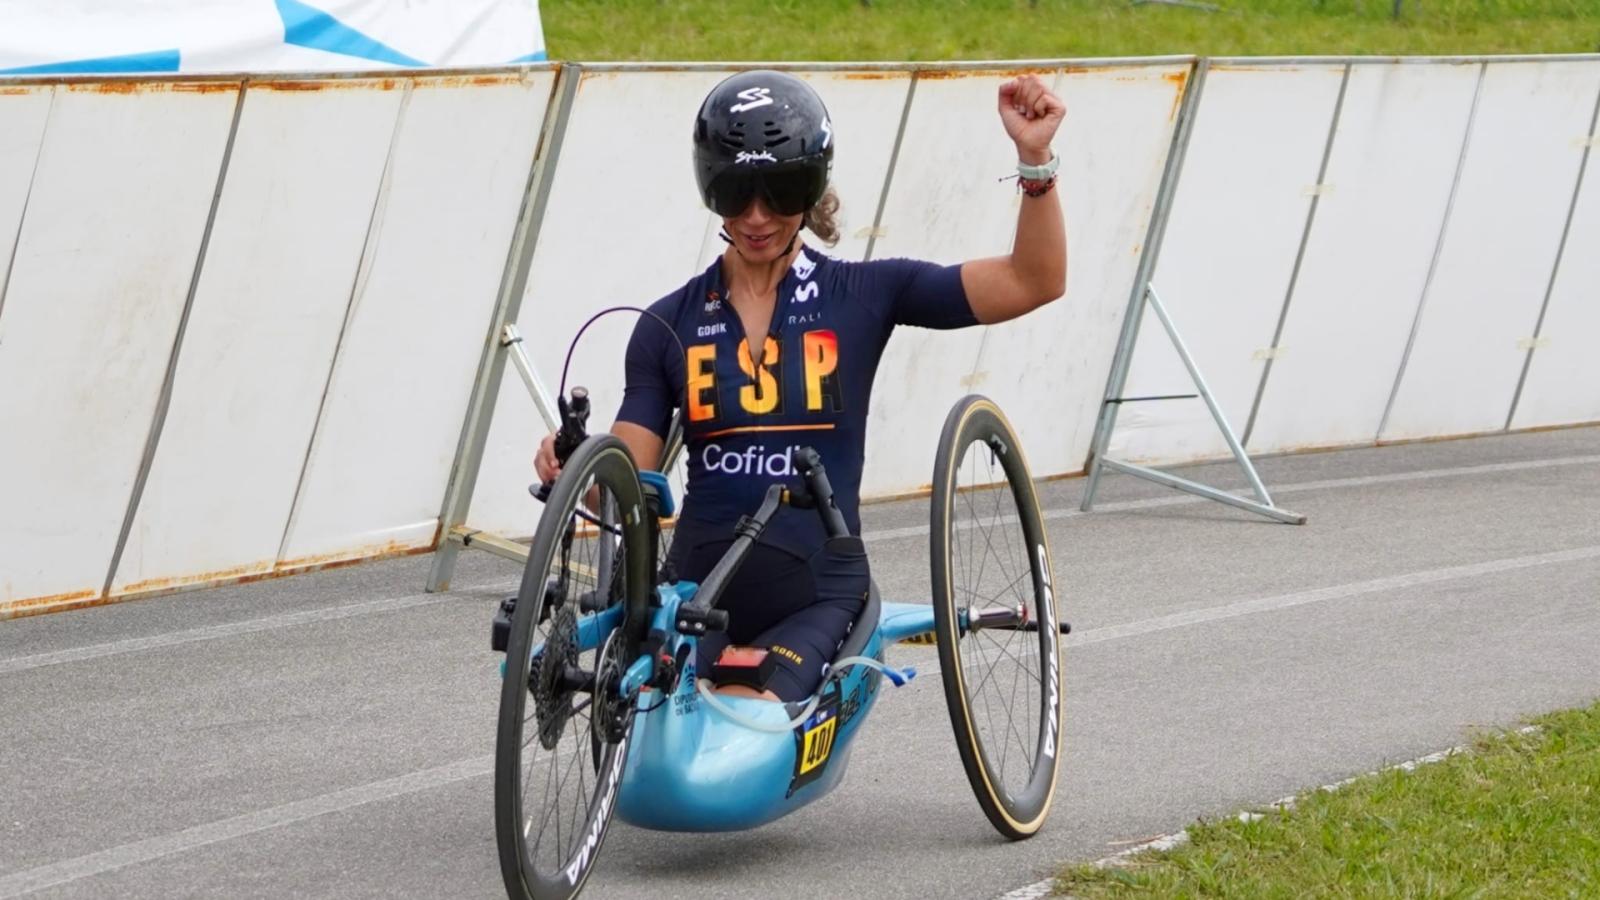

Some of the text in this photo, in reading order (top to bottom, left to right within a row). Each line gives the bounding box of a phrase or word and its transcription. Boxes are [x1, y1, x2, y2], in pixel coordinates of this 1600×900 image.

[697, 322, 727, 337] GOBIK
[702, 443, 812, 476] Cofidi
[771, 645, 804, 665] GOBIK
[1037, 543, 1060, 760] CORIMA
[806, 722, 833, 766] 401
